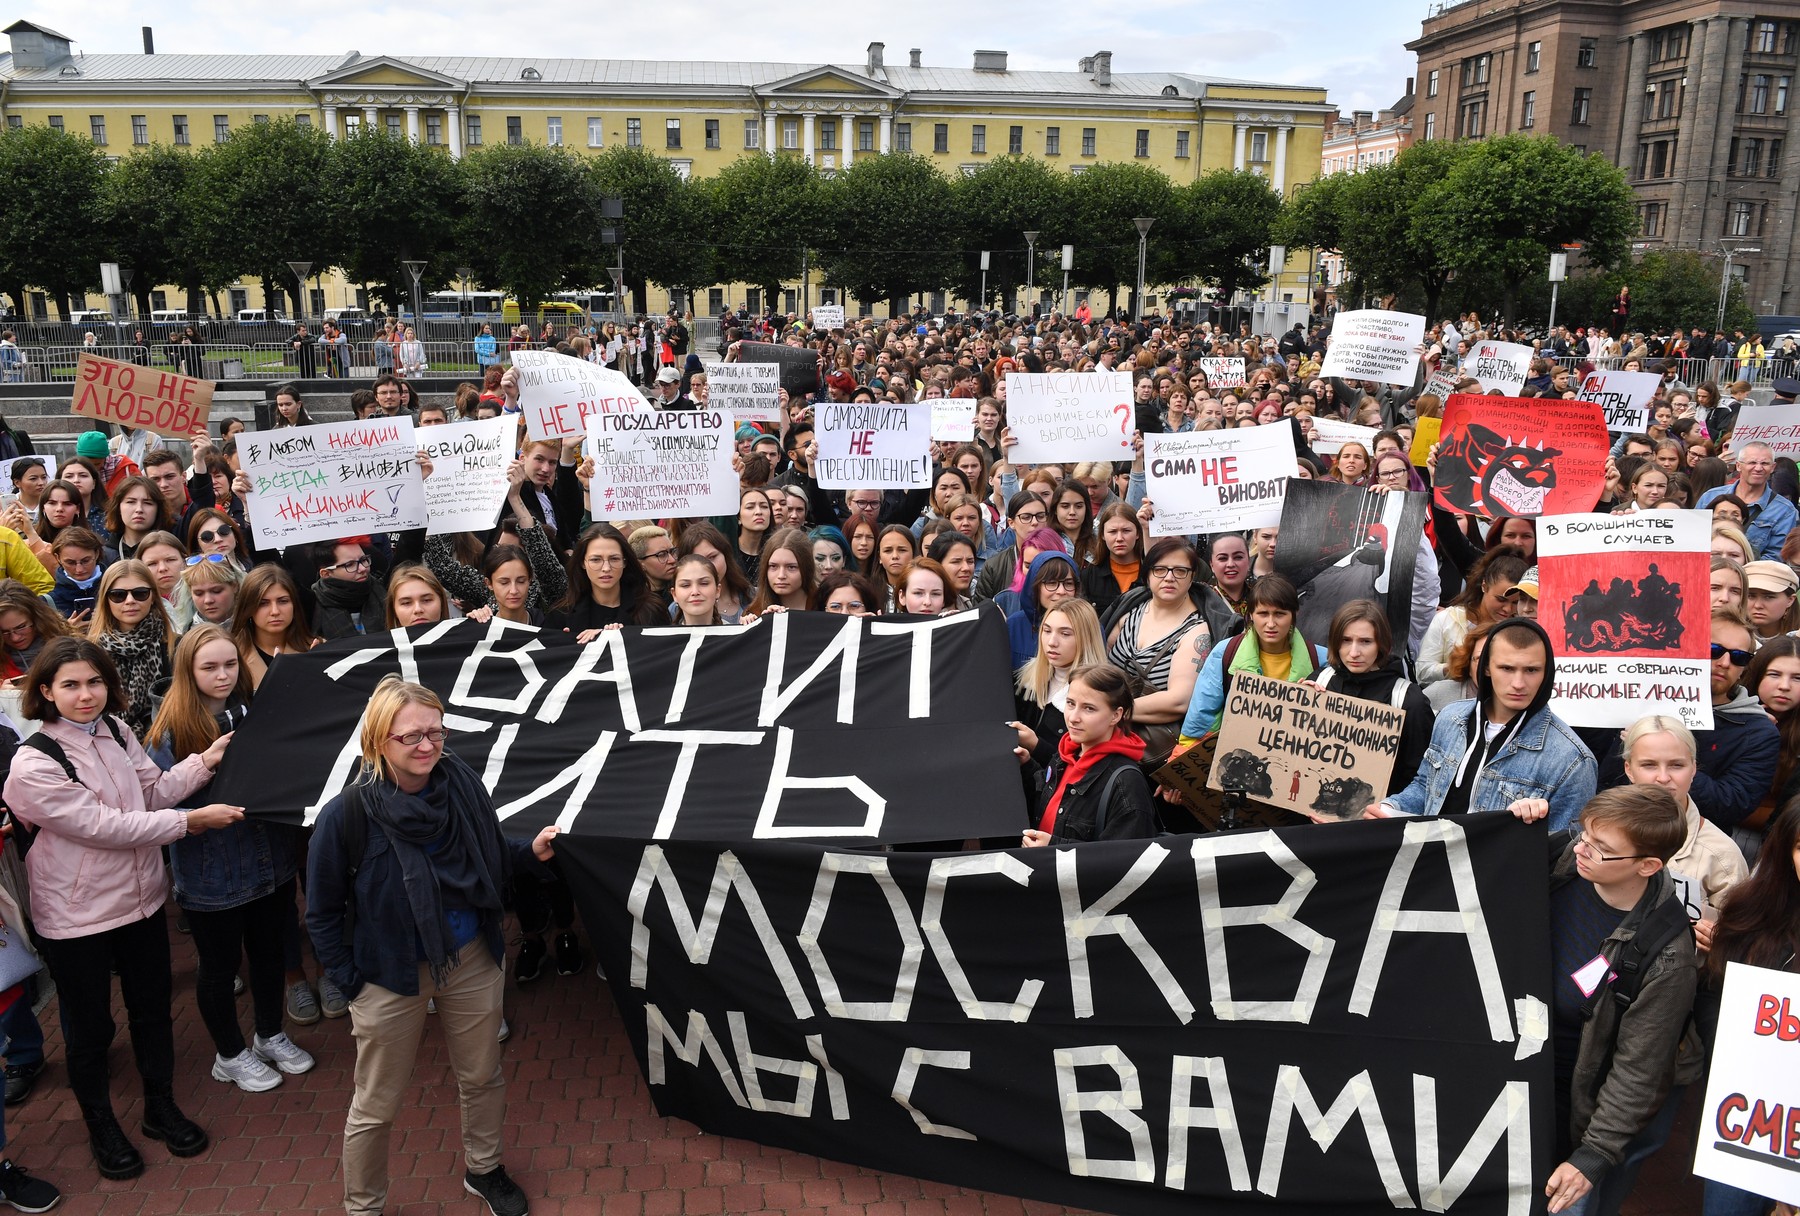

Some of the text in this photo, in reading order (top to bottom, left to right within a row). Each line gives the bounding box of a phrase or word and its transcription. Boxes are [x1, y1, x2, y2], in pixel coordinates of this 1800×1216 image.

[1355, 324, 1394, 333] СЧАСТЛИВО,
[1382, 319, 1404, 327] ДОЛГО
[1388, 334, 1405, 342] УБИЛ
[751, 345, 802, 357] ТРЕБУЕМ
[1353, 351, 1377, 360] ЧТОБЫ
[1377, 354, 1409, 365] ПРИНЯТЬ
[1366, 345, 1381, 353] ЕЩЕ
[1382, 347, 1408, 356] НУЖНО
[516, 353, 549, 369] ВЫБОР
[1202, 358, 1243, 366] СКАЖЕМ
[1362, 360, 1401, 371] ДОМАШНЕМ
[1477, 357, 1517, 372] СЕСТРЫ
[522, 368, 588, 387] ИЛИ СЕСТЬ В
[754, 366, 778, 379] ТЮРЬМА!
[1207, 372, 1245, 380] УЛЬТУРЕ
[1345, 366, 1383, 377] НАСИЛИИ?!
[1476, 369, 1524, 384] ХАЧАТУРЯН
[82, 360, 198, 405] ЭТО НЕ
[580, 382, 597, 399] ЭТО
[751, 381, 779, 394] СВОБОДА!
[1012, 376, 1024, 395] А
[1029, 374, 1126, 396] НАСИЛИЕ
[1207, 378, 1245, 387] НАСИЛИЯ
[1054, 397, 1080, 407] ЭТО
[1465, 397, 1592, 410] ПРИНУЖДЕНИЯ ОБВИНЕНИЯ
[1579, 392, 1632, 409] СЕСТРЫ
[76, 383, 207, 435] ЛЮБОВЬ
[539, 404, 576, 436] НЕ
[603, 412, 723, 432] ГОСУДАРСТВО
[824, 405, 908, 432] САМОЗАЩИТА
[1011, 409, 1113, 427] ЭКОНОМИЧЕСКИ
[1485, 409, 1596, 429] МАНИПУЛЯЦИИ НАКАЗАНИЯ
[1039, 423, 1108, 443] ВЫГОДНО
[1501, 423, 1545, 434] ИЗОЛЯЦИЯ
[1561, 431, 1605, 439] КОНТРОЛЬ
[248, 444, 262, 465] В
[268, 435, 316, 460] ЛЮБОМ
[327, 425, 400, 452] НАСИЛИИ
[597, 437, 615, 453] НЕ
[849, 430, 875, 456] НЕ
[1559, 441, 1606, 451] ДАВЛЕНИЕ
[598, 449, 717, 466] ЗАЩИЩАЕТ НАКАЗЫВАЕТ
[602, 462, 709, 475] ТРЕБУЕМ ЗАКОН ПРОТИВ
[819, 454, 928, 484] ПРЕСТУПЛЕНИЕ!
[1151, 456, 1240, 487] САМА НЕ
[255, 458, 415, 496] ВСЕГДА ВИНОВАТ
[424, 475, 452, 484] егионы
[612, 472, 660, 484] ДОМАШНЕГО
[1496, 473, 1513, 486] РАДИ
[1218, 475, 1291, 506] ВИНОВАТ
[1495, 482, 1523, 499] ТВОЕГО
[274, 489, 380, 523] НАСИЛЬНИК
[1206, 519, 1216, 529] НЕ
[1546, 518, 1675, 536] В БОЛЬШИНСТВЕ
[1603, 534, 1675, 545] СЛУЧАЕВ
[324, 608, 979, 733] ХВАТИТ
[1554, 662, 1703, 677] АСИЛИЕ СОВЕРШАЮТ
[1550, 681, 1701, 703] ЗНАКОМЫЕ ЛЮДИ
[1236, 674, 1401, 732] НЕНАВИСТЬ К ЖЕНЩИНАМ
[1230, 695, 1400, 758] САМАЯ ТРАДИЦИОННАЯ
[1258, 726, 1356, 770] ЦЕННОСТЬ
[627, 818, 1549, 1062] МОСКВА,
[643, 1001, 1532, 1216] МЫ С ВАМИ
